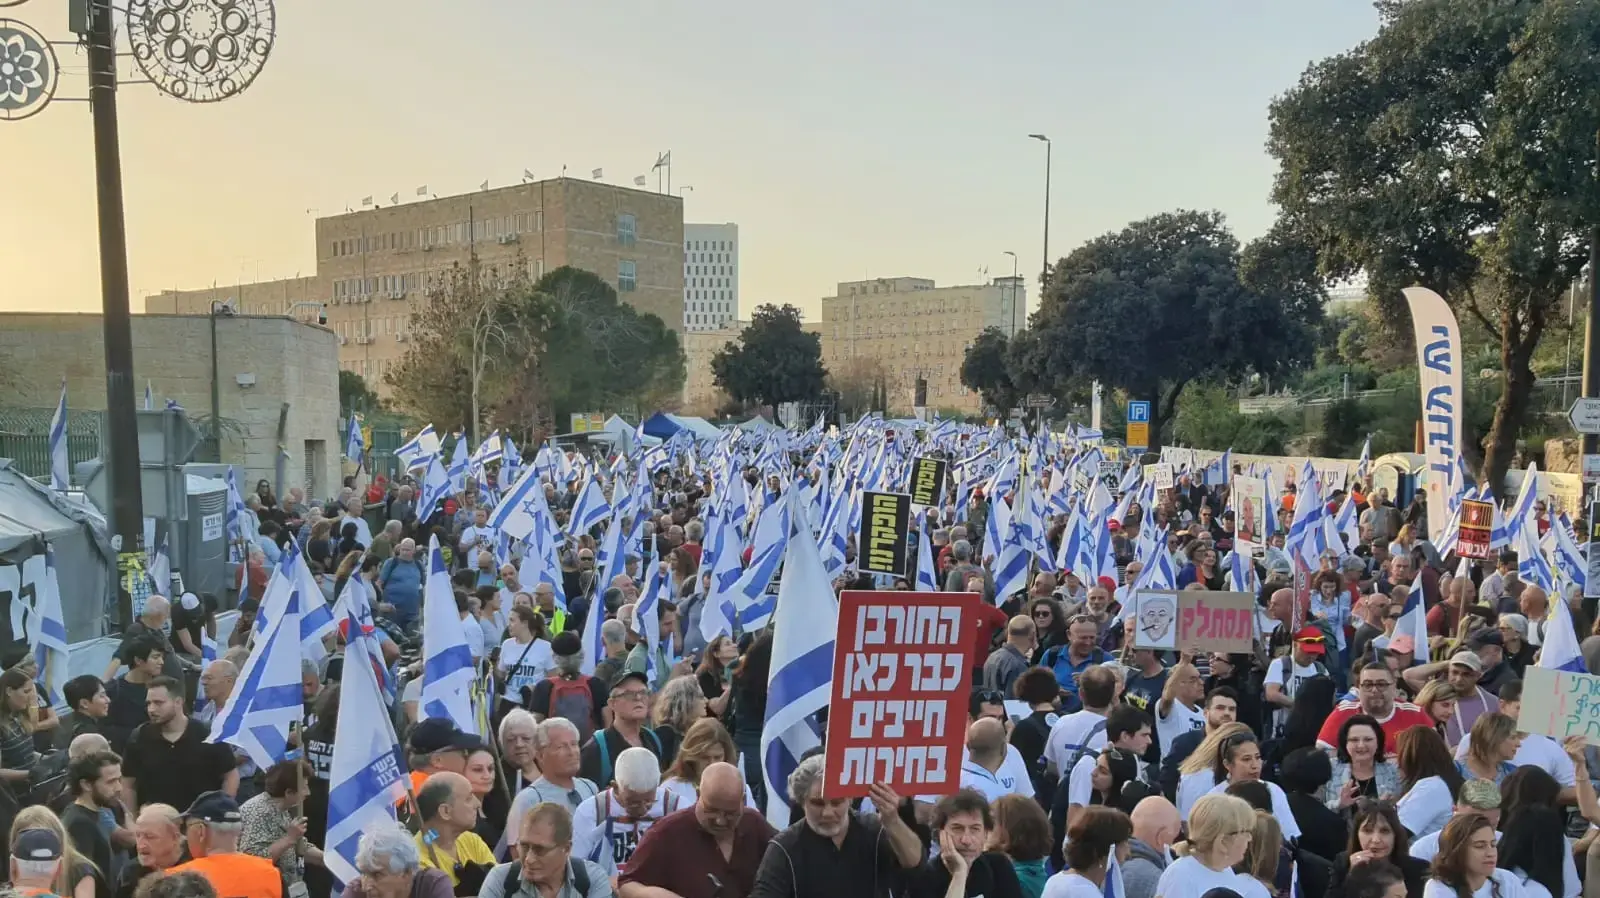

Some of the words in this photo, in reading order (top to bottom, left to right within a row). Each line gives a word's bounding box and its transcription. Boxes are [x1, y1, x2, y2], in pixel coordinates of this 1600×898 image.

[868, 494, 898, 572] הופקרנו!
[853, 605, 962, 652] החורבן
[842, 653, 899, 700] כאן
[903, 653, 964, 692] כבר
[850, 700, 948, 739] חייבים
[370, 753, 397, 773] פשי
[376, 766, 401, 787] רצנו
[839, 746, 948, 786] בחירות
